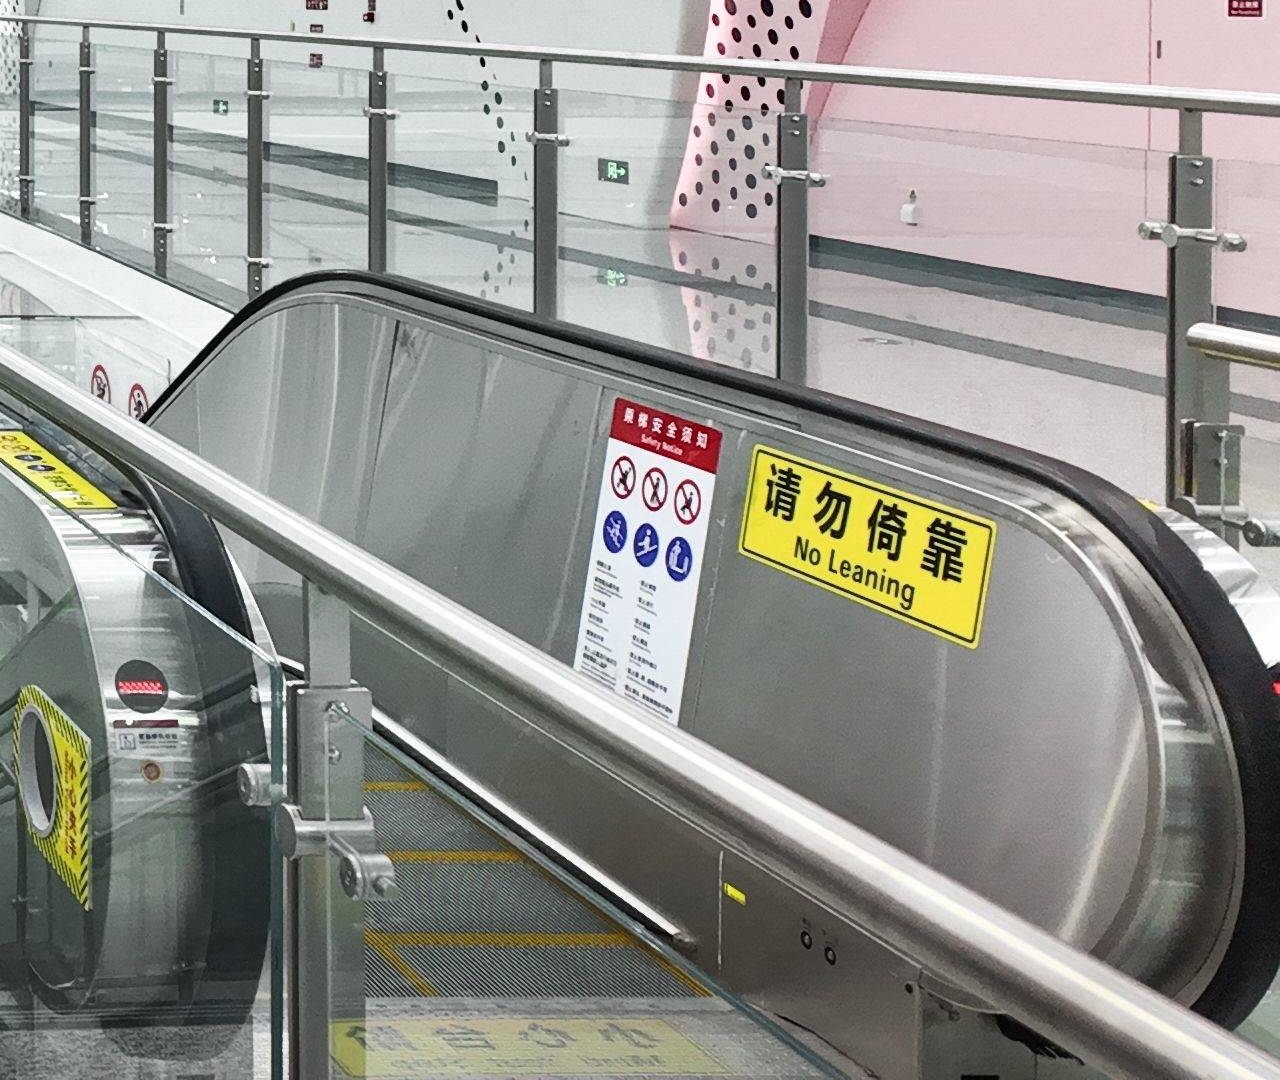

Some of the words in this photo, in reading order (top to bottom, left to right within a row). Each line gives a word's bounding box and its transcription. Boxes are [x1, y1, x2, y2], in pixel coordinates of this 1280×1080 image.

[764, 463, 968, 583] 请勿倚靠
[794, 536, 821, 566] No
[829, 549, 915, 610] Leaning
